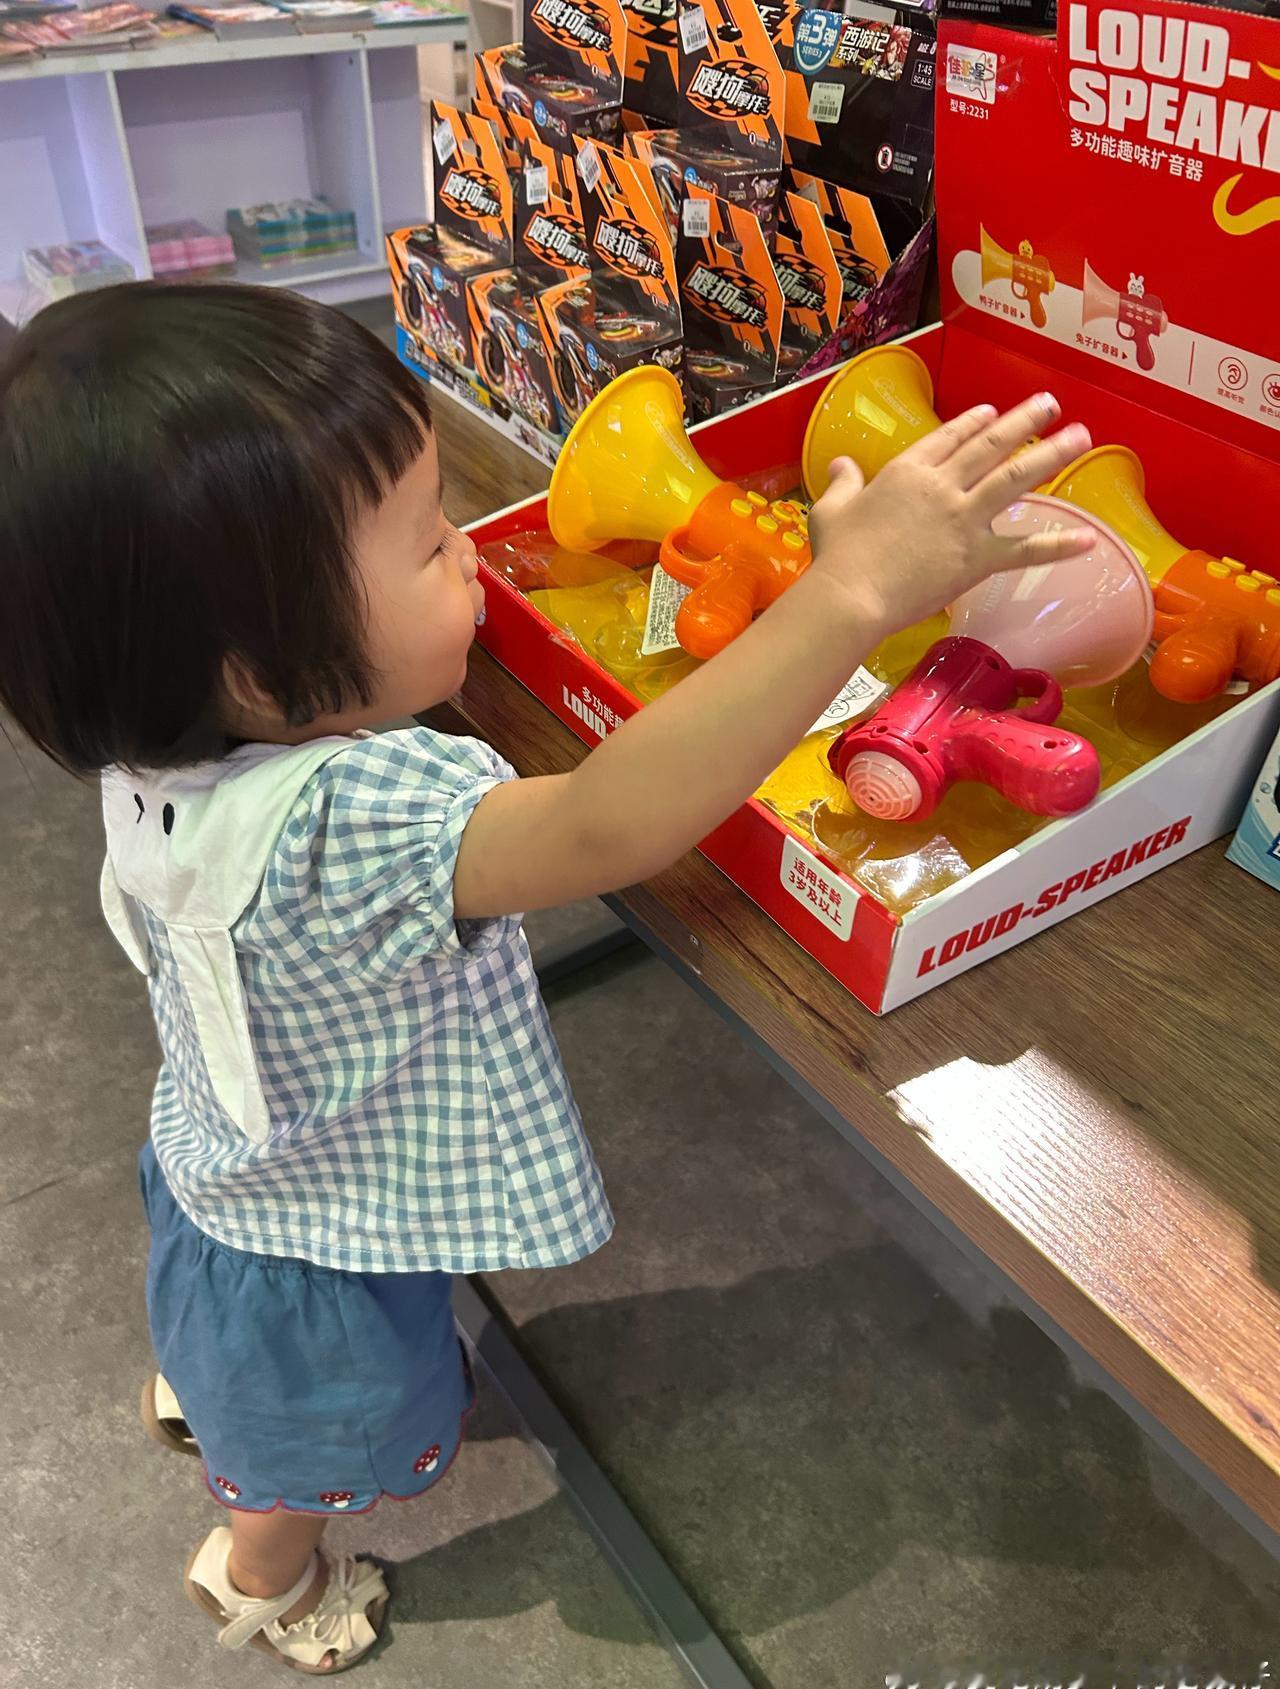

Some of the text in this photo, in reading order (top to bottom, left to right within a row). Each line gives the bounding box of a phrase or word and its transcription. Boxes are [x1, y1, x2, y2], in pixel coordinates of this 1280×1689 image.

[796, 13, 838, 48] 第3弹
[841, 25, 891, 53] 西游记
[835, 45, 860, 63] 系列
[917, 42, 930, 54] AGE
[1068, 2, 1251, 90] LOUD-
[912, 74, 932, 87] SCALE
[917, 63, 933, 76] 1:45
[949, 97, 990, 121] 型号:2231
[1068, 127, 1204, 183] 多功能趣味扩音器
[978, 293, 1018, 319] 鸭子扩音器
[1075, 331, 1119, 359] 兔子扩音器
[793, 856, 843, 908] 适用年龄
[787, 870, 842, 927] 3岁及以上
[916, 814, 1193, 979] LOUD-SPEAKER
